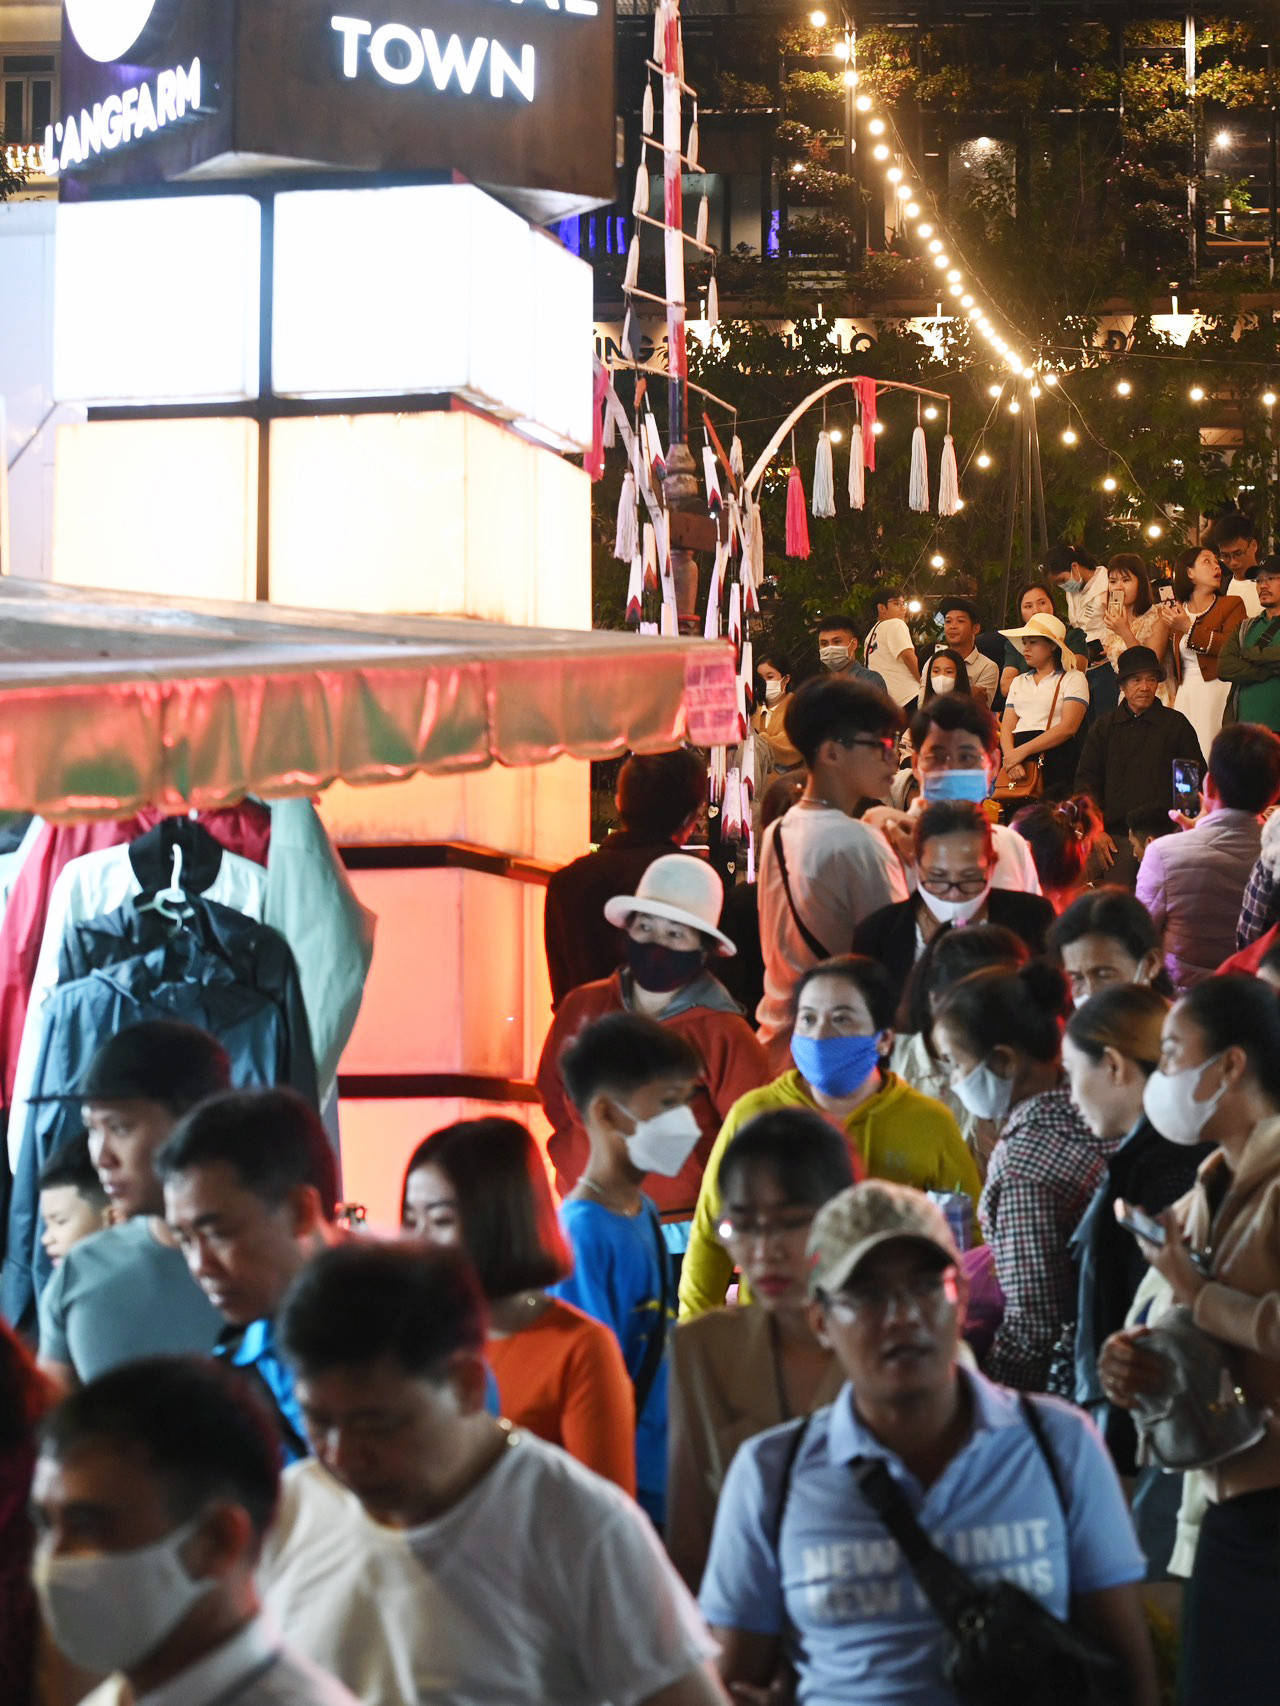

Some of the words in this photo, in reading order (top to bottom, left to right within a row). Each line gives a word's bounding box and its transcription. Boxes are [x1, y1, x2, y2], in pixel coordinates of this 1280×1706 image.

[330, 15, 535, 103] TOWN
[44, 56, 201, 176] L'ANGFARM
[803, 1540, 898, 1578] NEW
